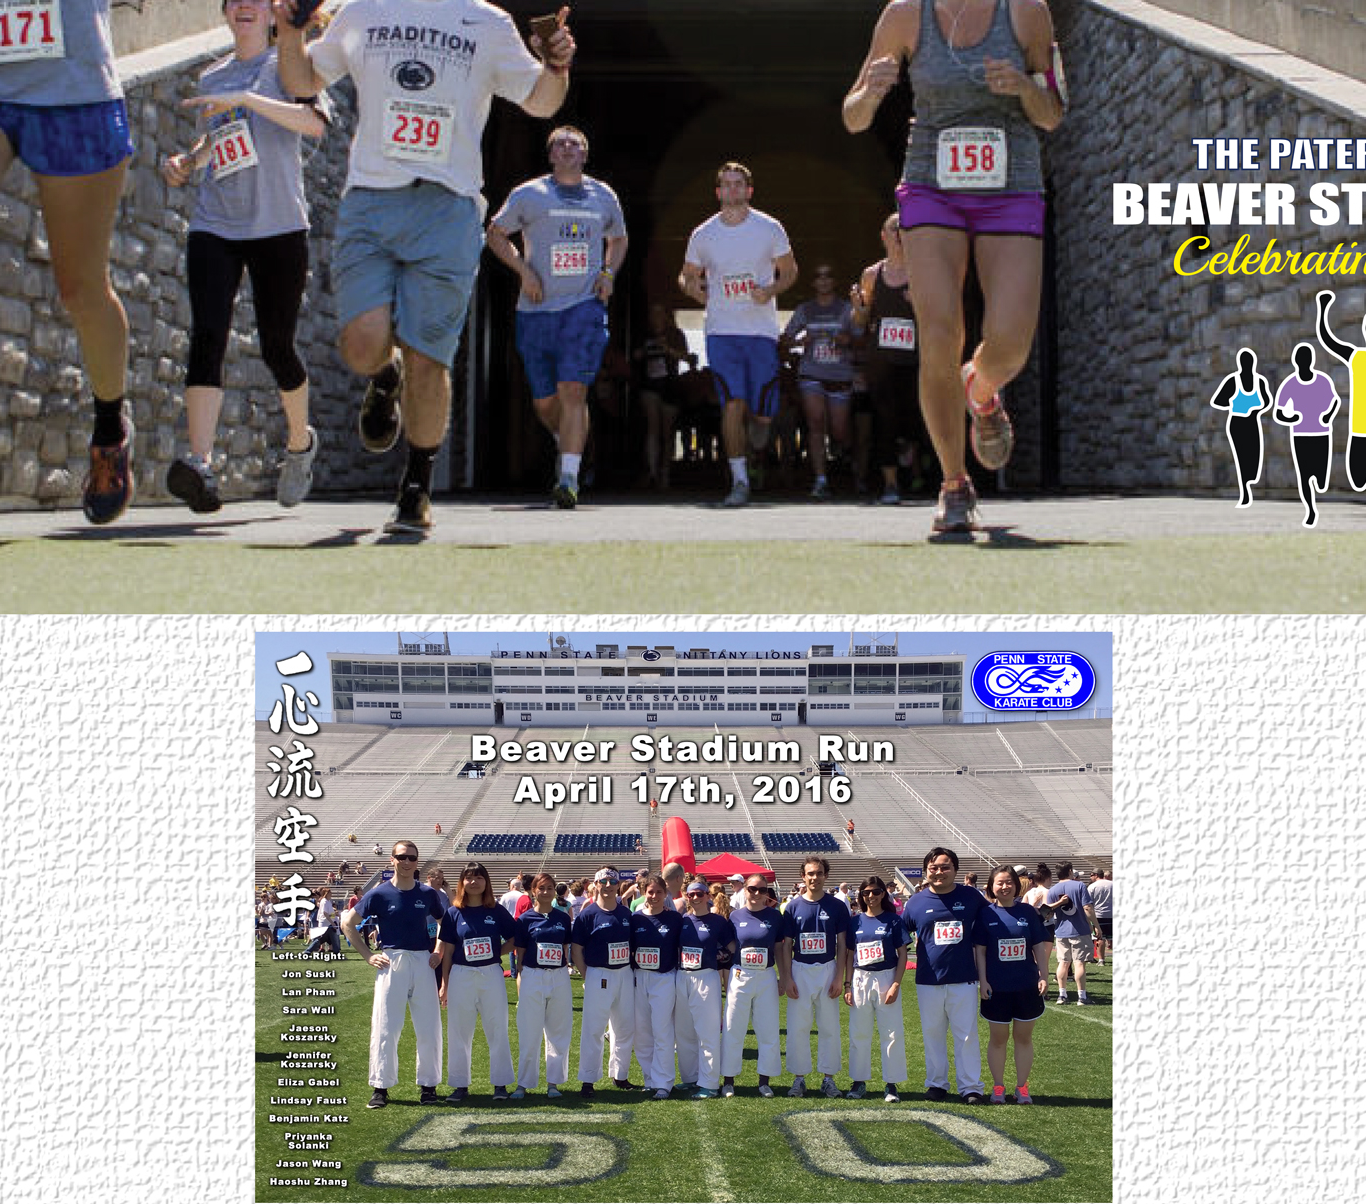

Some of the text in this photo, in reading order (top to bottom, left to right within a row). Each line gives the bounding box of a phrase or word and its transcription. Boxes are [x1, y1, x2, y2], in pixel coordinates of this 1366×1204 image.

[366, 23, 477, 55] TRADITION
[391, 114, 441, 147] 239
[949, 142, 996, 174] 158
[553, 251, 587, 270] 2266
[501, 651, 802, 659] PENN STATE NITTANY LIONS
[585, 694, 719, 702] BEAVER STADIUM
[936, 927, 961, 939] 1432
[467, 943, 491, 956] 1253
[1000, 944, 1025, 957] 2197
